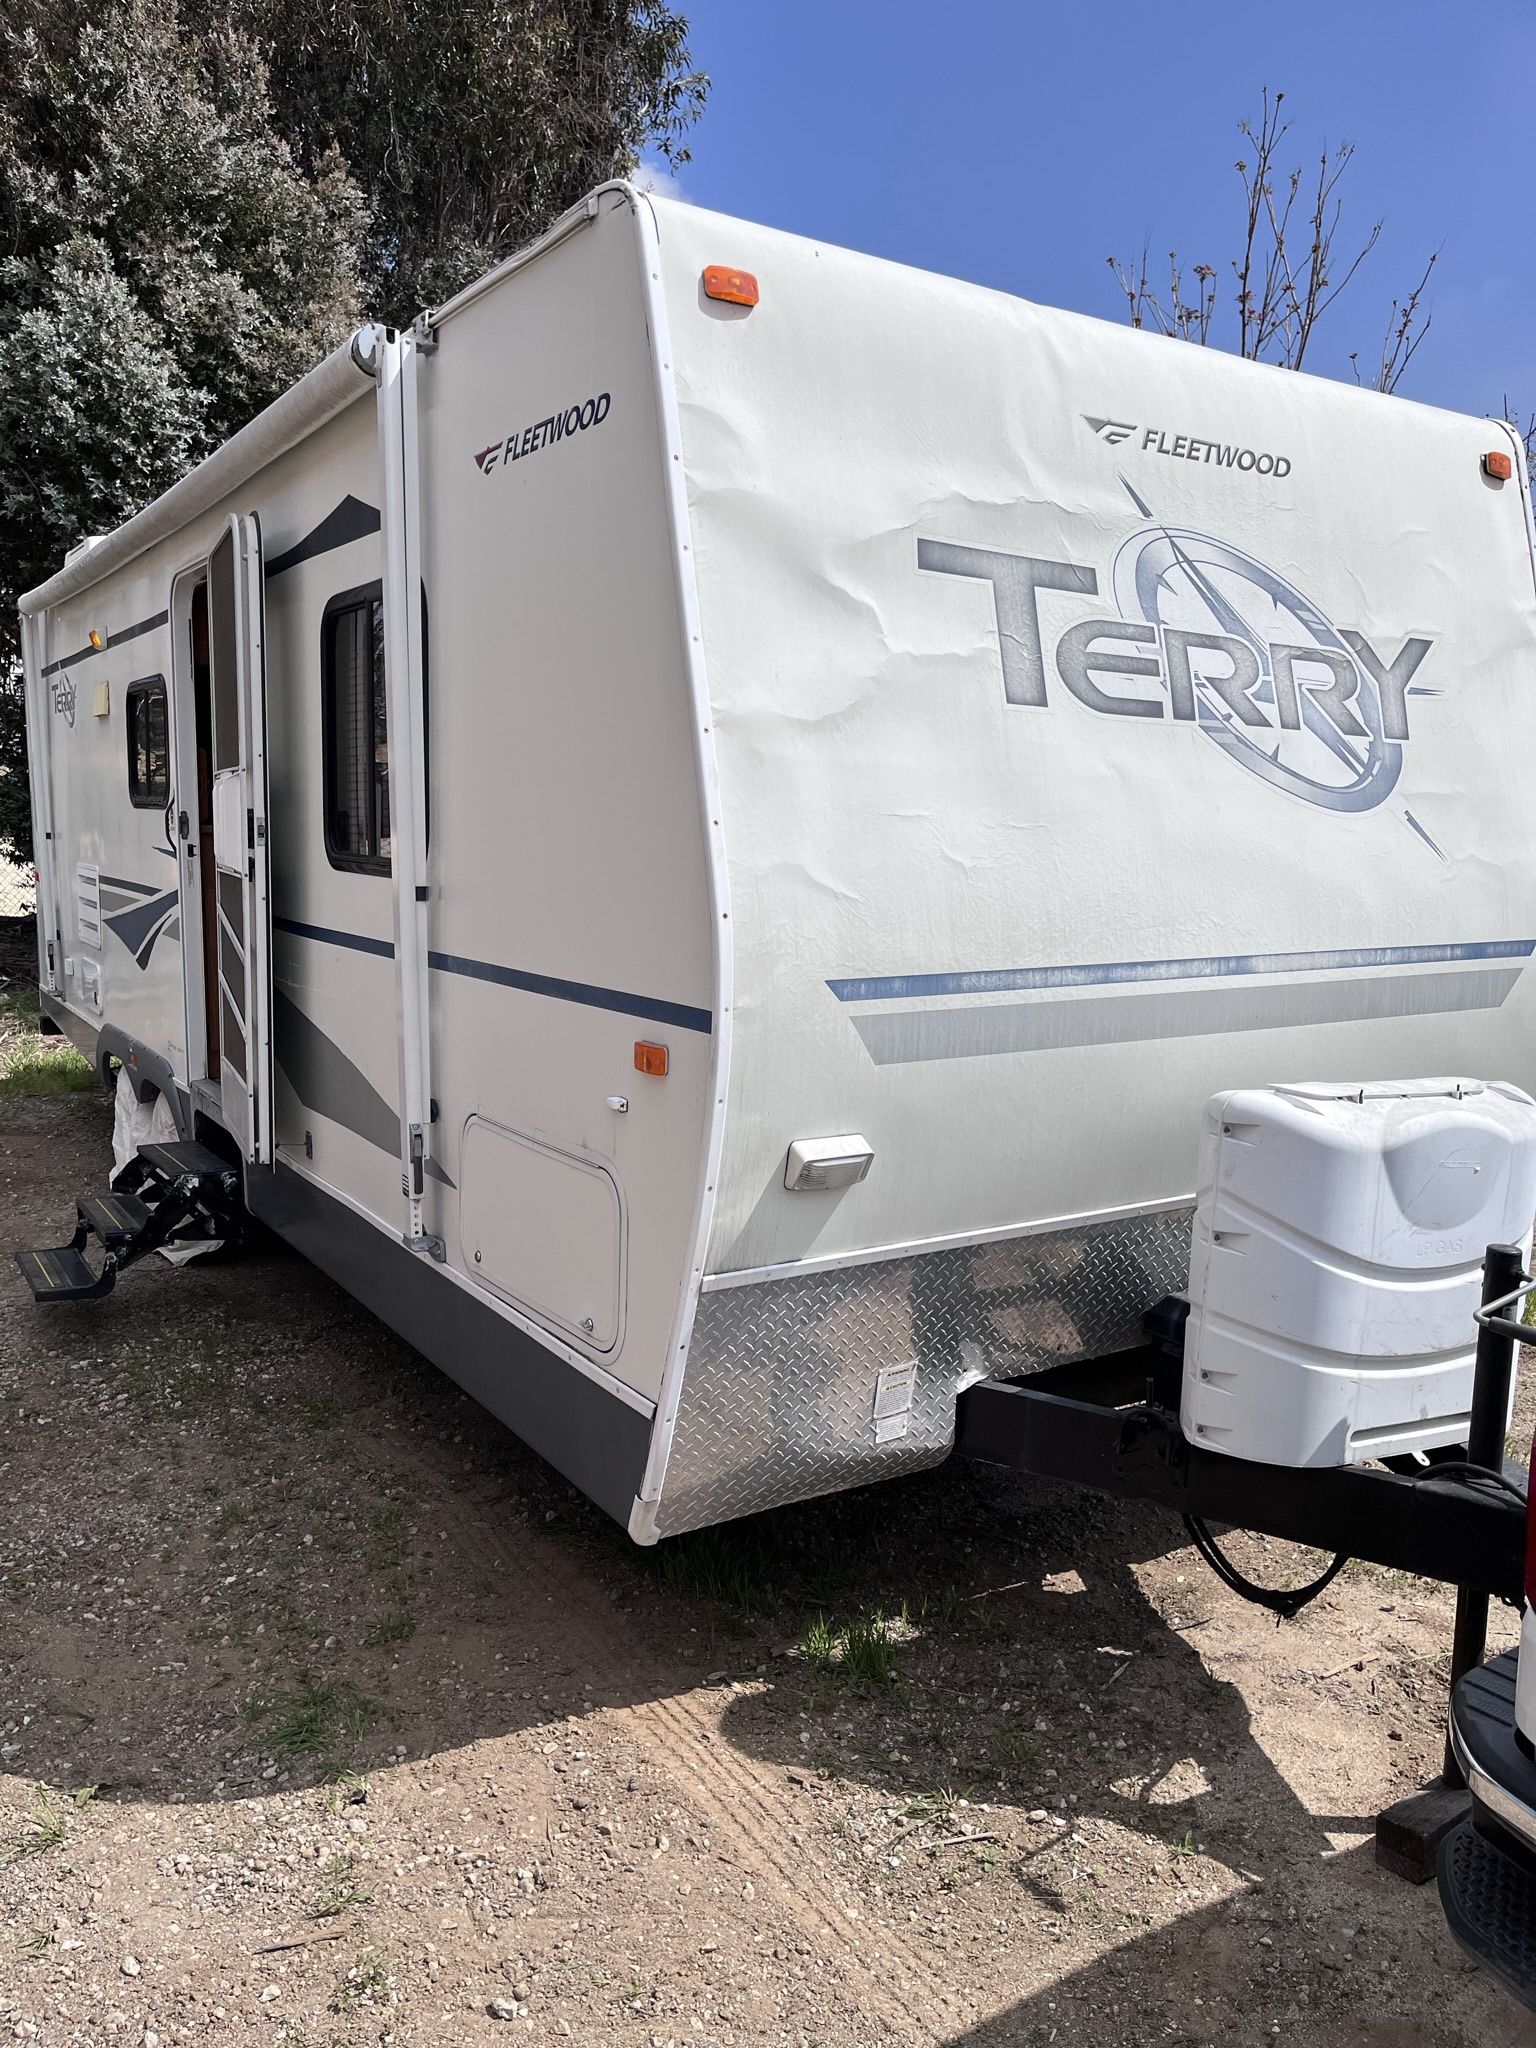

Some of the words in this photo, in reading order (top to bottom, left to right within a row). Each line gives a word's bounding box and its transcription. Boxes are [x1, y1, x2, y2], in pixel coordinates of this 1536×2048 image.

[504, 392, 611, 465] FLEETWOOD
[1141, 429, 1292, 478] FLEETWOOD
[917, 537, 1433, 741] TERRY
